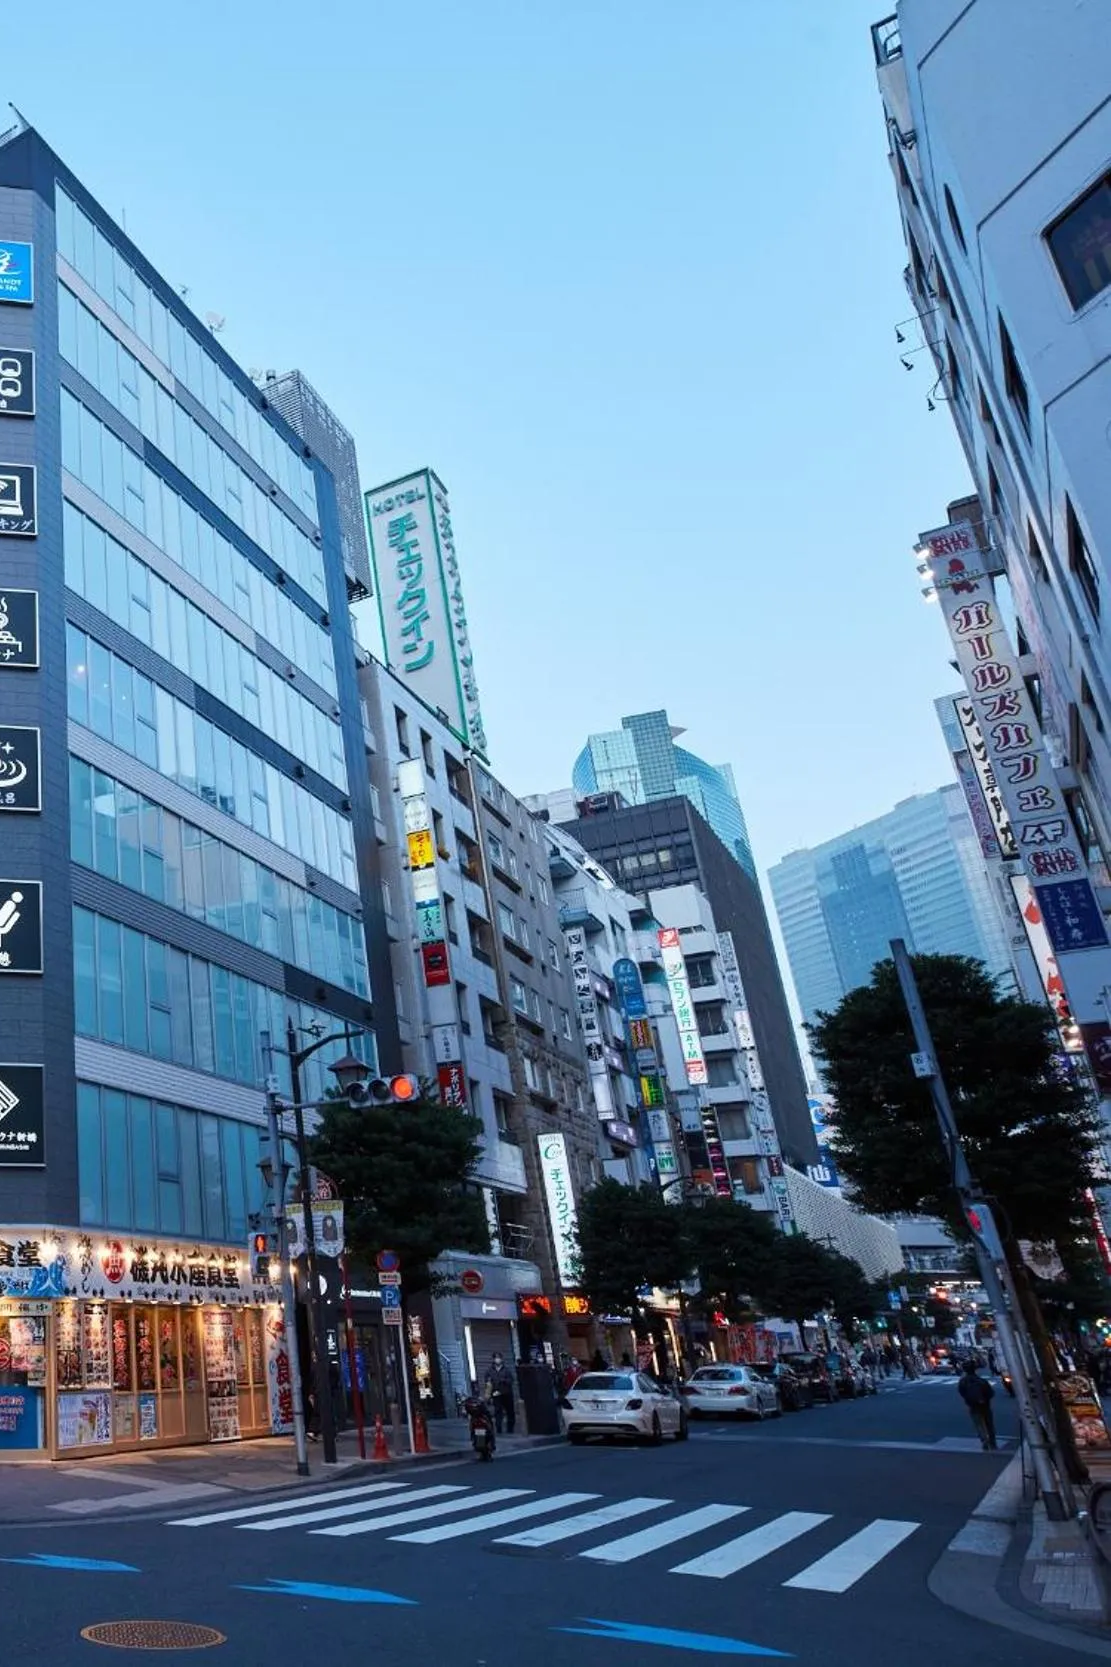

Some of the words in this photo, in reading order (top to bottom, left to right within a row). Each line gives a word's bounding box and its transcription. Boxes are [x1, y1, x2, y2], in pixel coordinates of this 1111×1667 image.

[372, 487, 426, 516] HOTEL
[388, 511, 435, 673] チェックイン
[1021, 820, 1066, 844] 4F
[686, 1034, 699, 1059] ATM
